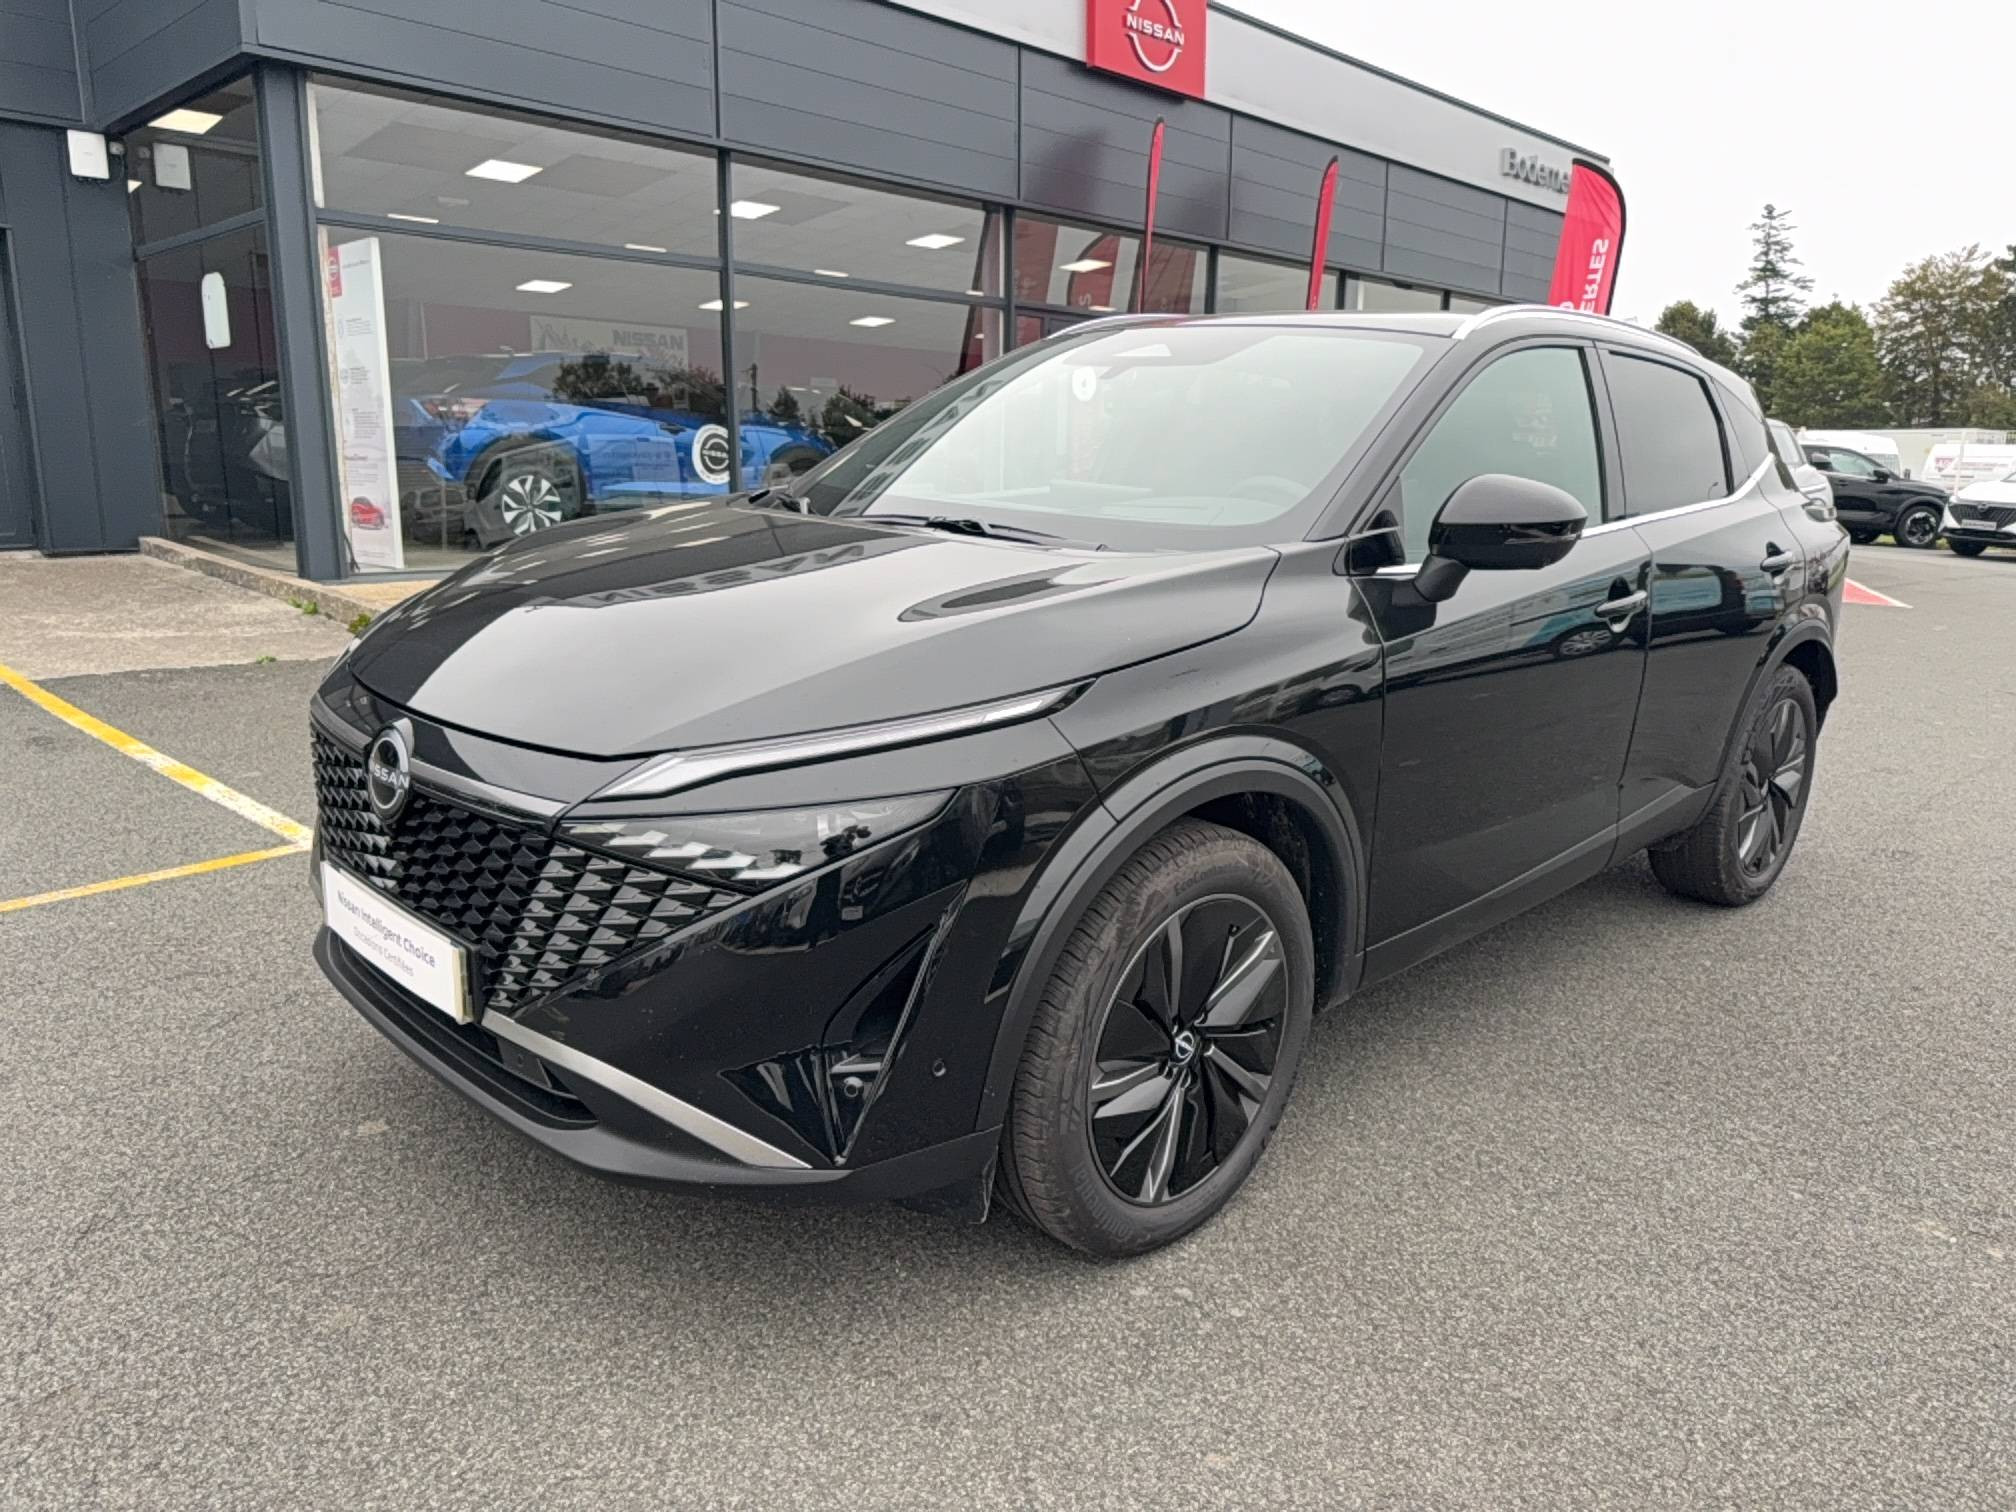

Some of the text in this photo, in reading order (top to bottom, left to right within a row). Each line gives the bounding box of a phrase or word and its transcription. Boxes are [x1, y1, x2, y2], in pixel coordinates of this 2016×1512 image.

[1126, 12, 1185, 46] NISSAN
[1501, 148, 1569, 193] Bodeme
[613, 330, 684, 350] NISSAN
[371, 761, 411, 790] SSAN
[337, 889, 436, 969] Nissan Intelligent Choice
